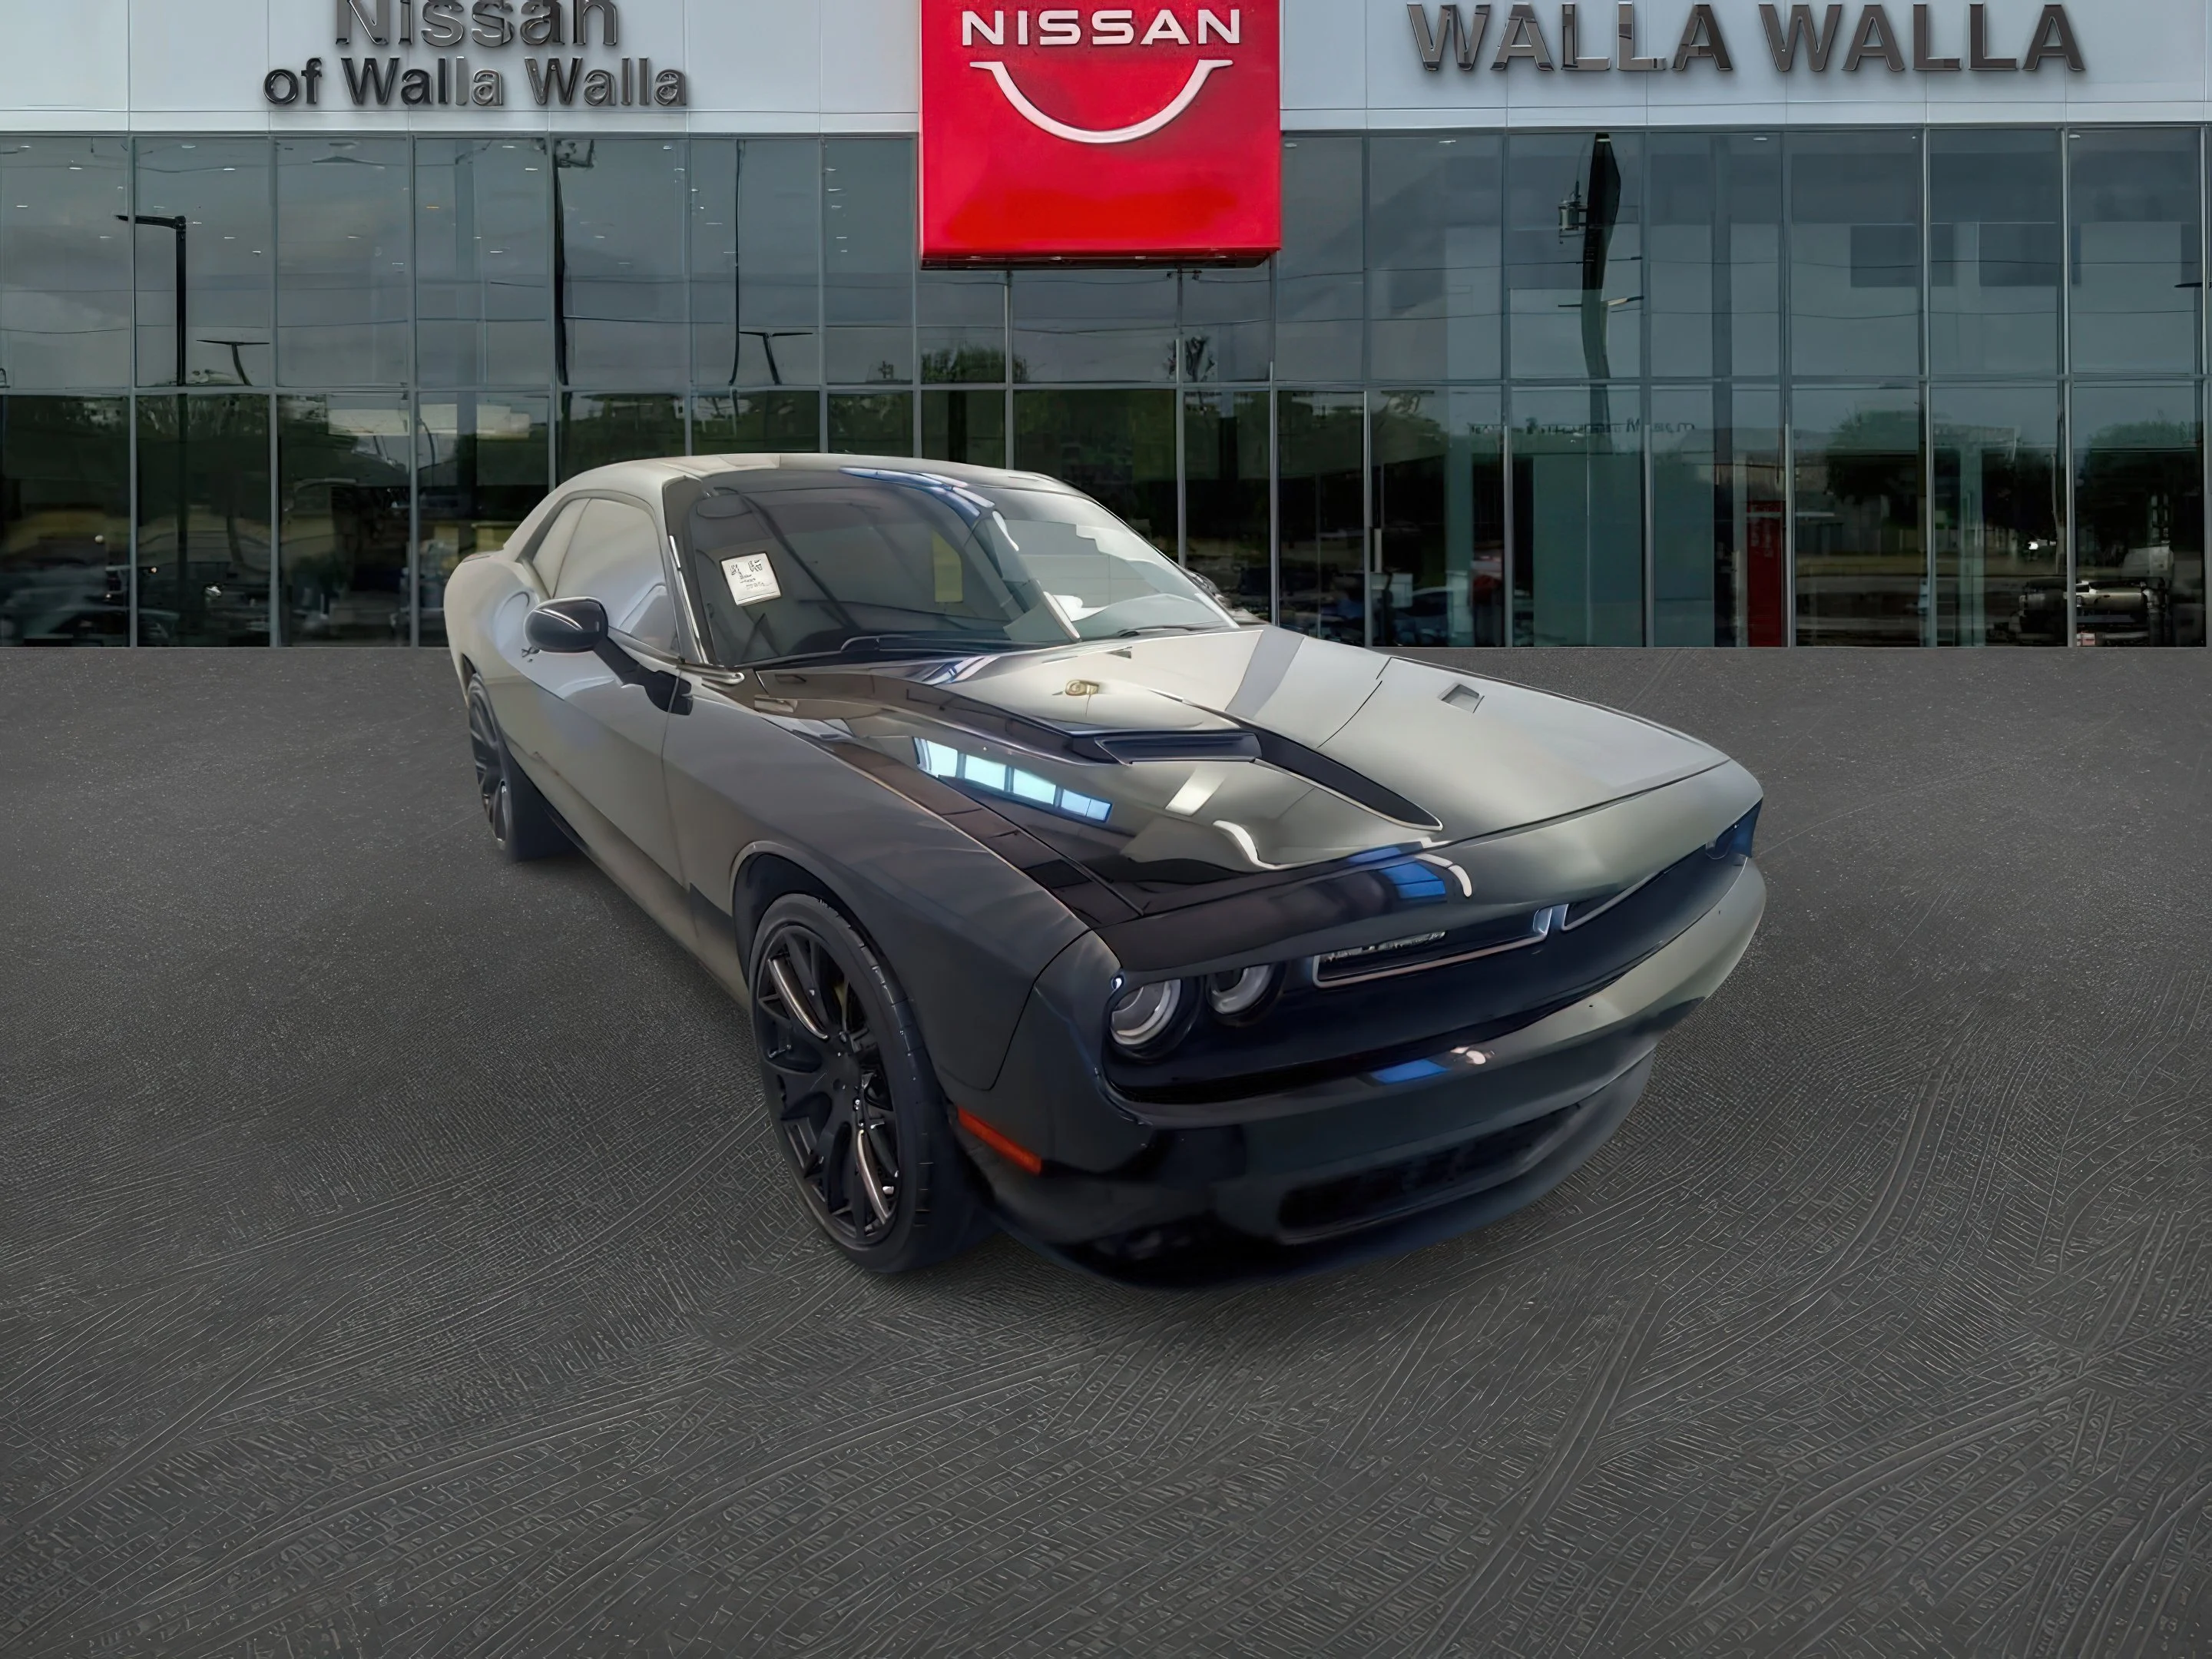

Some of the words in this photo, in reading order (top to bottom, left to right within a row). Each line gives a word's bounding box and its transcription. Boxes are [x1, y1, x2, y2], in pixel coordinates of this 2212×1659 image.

[962, 8, 1240, 46] NISSAN
[1407, 2, 1733, 72] WALLA
[1758, 2, 2085, 72] WALLA
[263, 57, 323, 105] of
[340, 56, 504, 106] Walla
[524, 56, 687, 106] Walla
